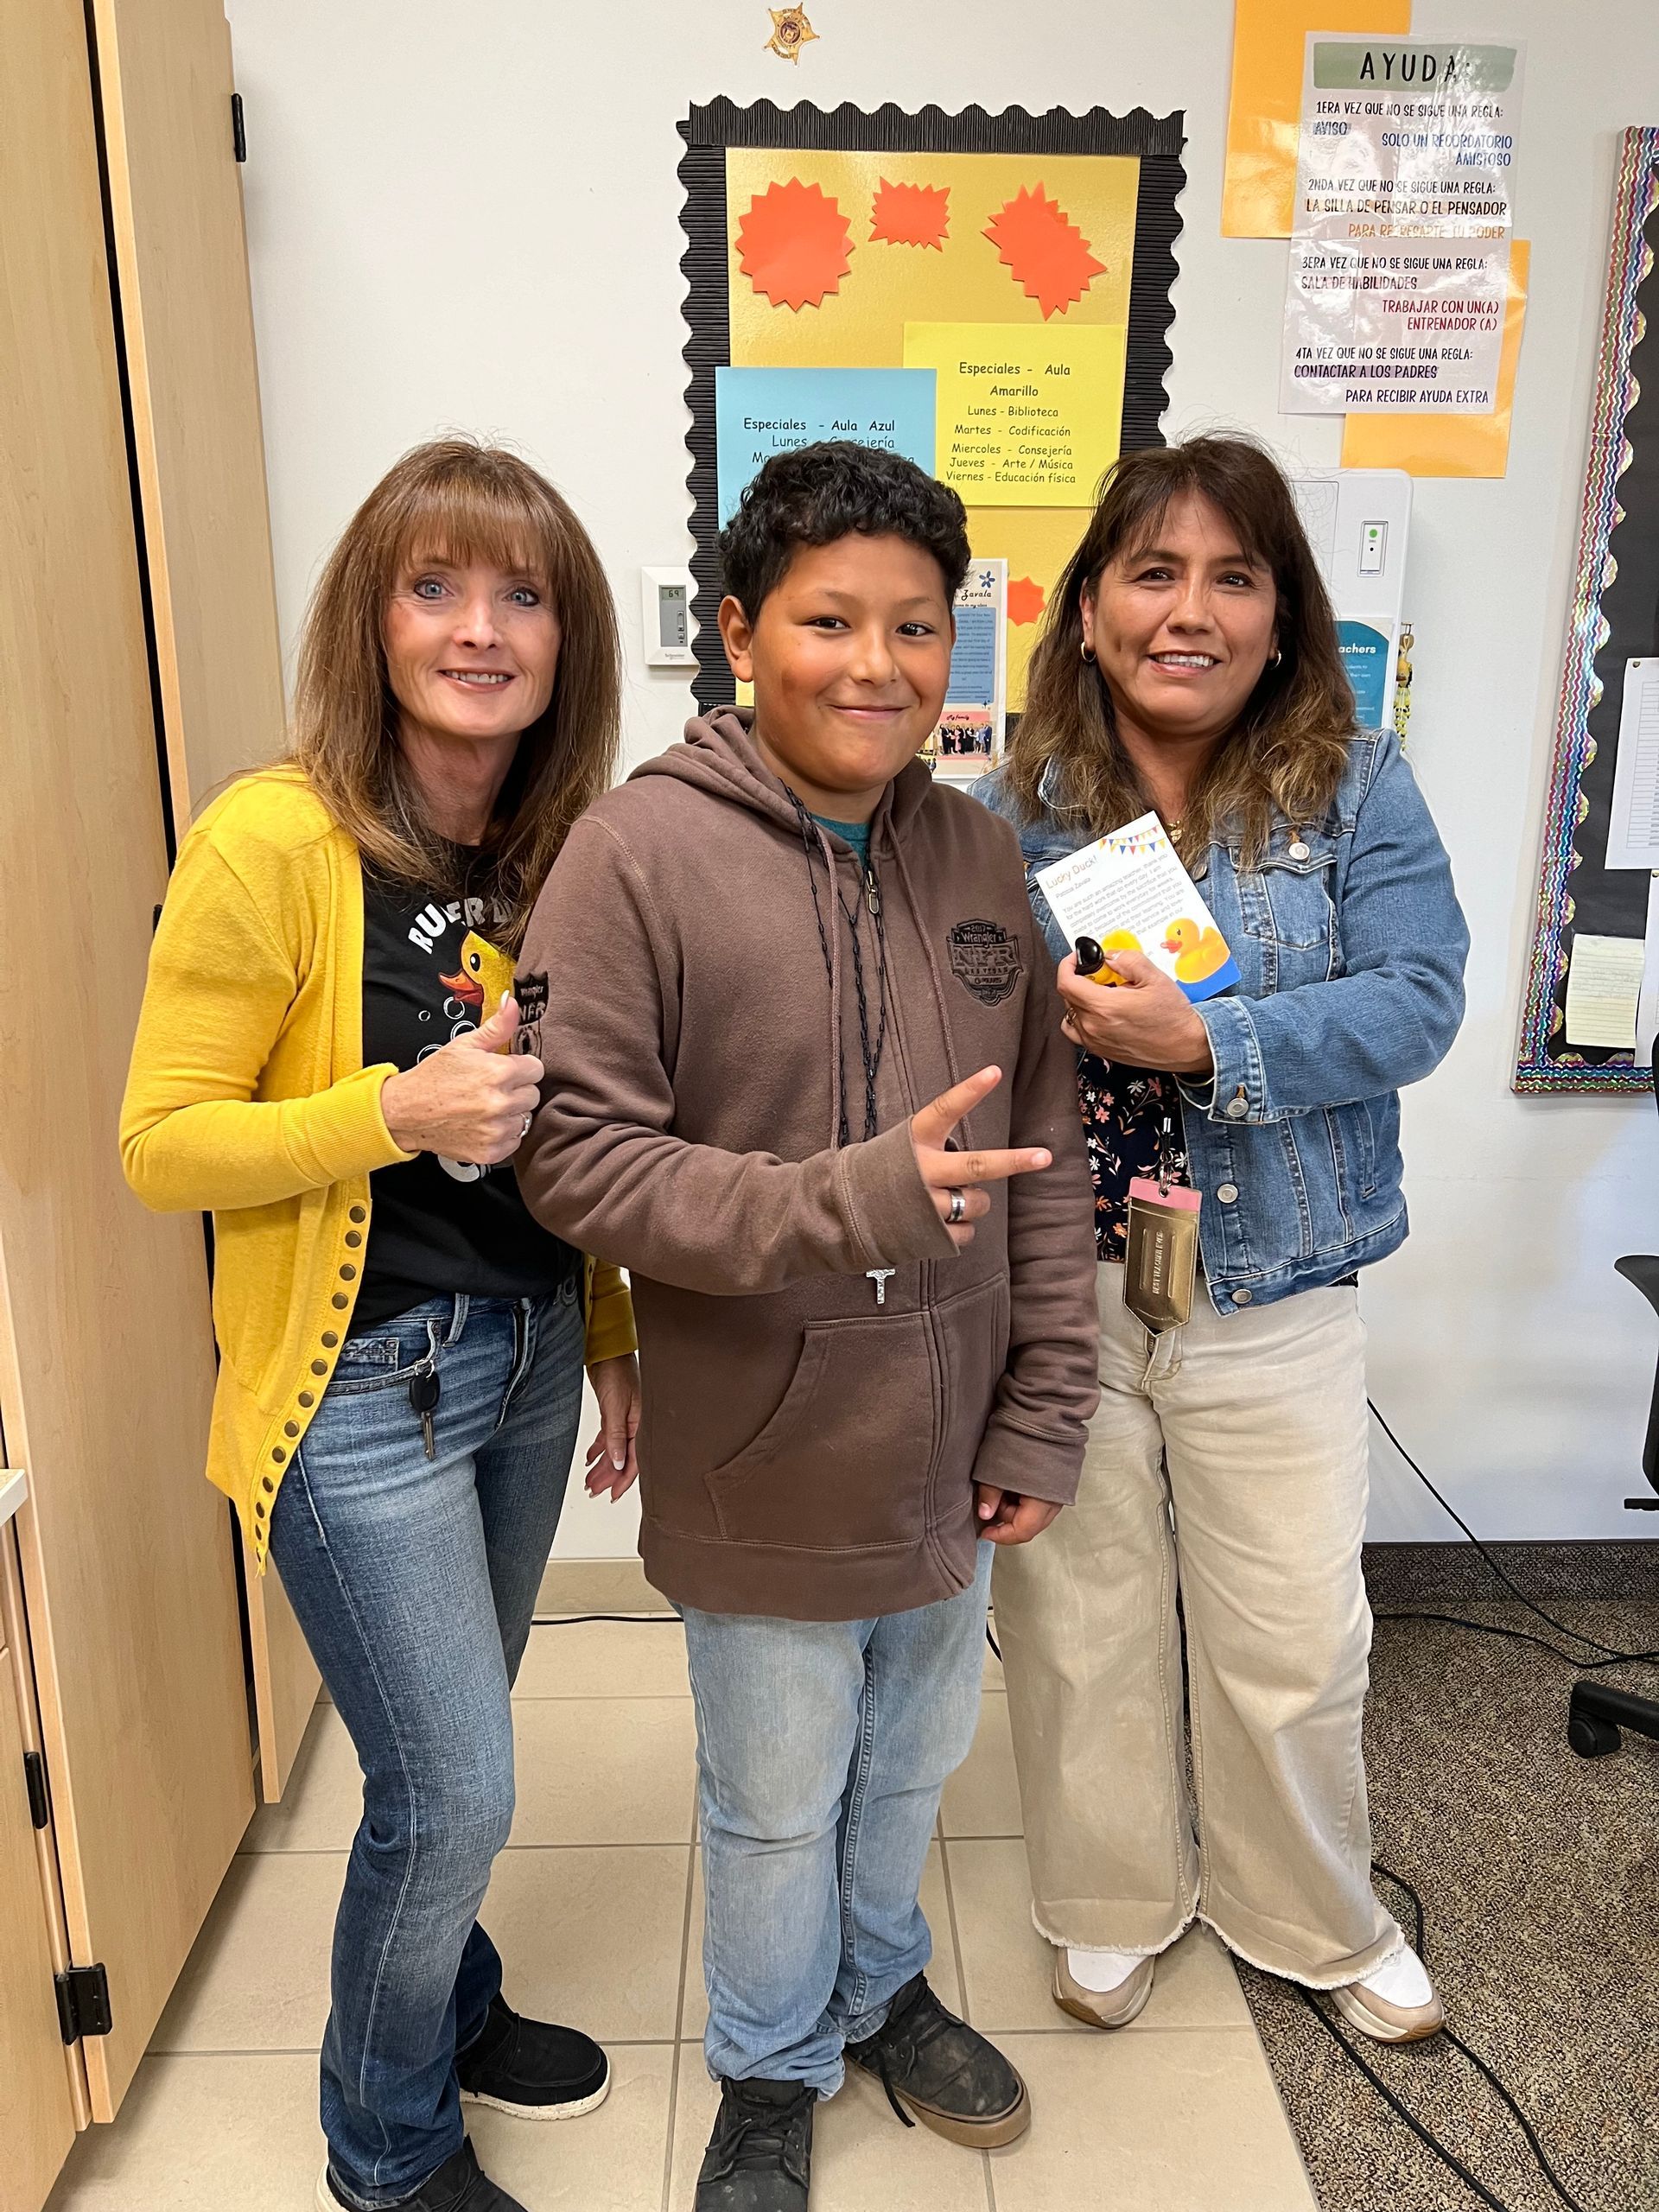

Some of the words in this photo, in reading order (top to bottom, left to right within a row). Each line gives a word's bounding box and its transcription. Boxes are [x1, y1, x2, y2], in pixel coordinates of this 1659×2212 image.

[1317, 102, 1339, 113] 1ERA
[1344, 102, 1362, 114] VEZ
[1365, 103, 1383, 116] QUE
[1387, 104, 1400, 116] NO
[1404, 105, 1414, 117] SE
[1419, 105, 1445, 117] SIGUE
[1448, 105, 1466, 117] UNA
[1471, 105, 1503, 118] REGLA:
[1314, 122, 1348, 135] AVISO
[1382, 133, 1408, 147] SOLO
[1414, 134, 1427, 147] UN
[1432, 134, 1512, 149] RECORDATORIO
[1456, 153, 1510, 166] AMISTOSO
[1308, 179, 1333, 191] 2NDA
[1339, 180, 1357, 191] VEZ
[1358, 180, 1376, 192] QUE
[1380, 181, 1394, 192] NO
[1396, 181, 1408, 193] SE
[1411, 181, 1437, 194] SIGUE
[1440, 181, 1459, 194] UNA
[1464, 181, 1496, 194] REGLA:
[1306, 199, 1321, 212] LA
[1325, 199, 1352, 212] SILLA
[1357, 200, 1370, 213] DE
[1375, 200, 1414, 214] PENSAR
[1421, 201, 1428, 213] O
[1432, 200, 1443, 214] EL
[1448, 201, 1507, 215] PENSADOR
[1349, 224, 1375, 238] PARA
[1380, 225, 1445, 238] RERESARTE
[1303, 257, 1325, 268] 3ERA
[1330, 257, 1346, 269] VEZ
[1351, 257, 1369, 269] QUE
[1372, 257, 1386, 269] NO
[1390, 257, 1400, 269] SE
[1404, 258, 1429, 269] SIGUE
[1433, 258, 1452, 270] UNA
[1456, 258, 1487, 270] REGLA:
[1301, 276, 1327, 289] SALA
[1332, 276, 1344, 289] DE
[1349, 276, 1417, 289] HABILIDADES
[1382, 300, 1437, 313] TRABAJAR
[1441, 301, 1463, 313] CON
[1467, 301, 1499, 314] UN(A)
[1408, 317, 1476, 330] ENTRENADOR
[1480, 318, 1497, 331] (A)
[1296, 347, 1312, 359] 4TA
[1317, 348, 1333, 359] VEZ
[1337, 348, 1355, 359] QUE
[1359, 348, 1372, 359] NO
[1376, 348, 1386, 359] SE
[1390, 348, 1414, 359] SIGUE
[1419, 349, 1437, 359] UNA
[1441, 349, 1472, 359] REGLA:
[959, 362, 1020, 377] Especiales
[1045, 364, 1071, 375] Aula
[1294, 365, 1357, 378] CONTACTAR
[1360, 365, 1366, 378] A
[1371, 365, 1390, 378] LOS
[1395, 365, 1437, 378] PADRES
[990, 385, 1038, 396] Amarillo
[1346, 390, 1372, 403] PARA
[1376, 390, 1416, 403] RECIBIR
[1420, 391, 1452, 403] AYUDA
[1457, 391, 1488, 403] EXTRA
[968, 406, 996, 416] Lunes
[1008, 406, 1058, 417] Biblioteca
[744, 418, 806, 431] Especiales
[831, 420, 857, 430] Aula
[869, 420, 894, 431] Azul
[955, 424, 991, 435] Martes
[1009, 426, 1071, 436] Codificación
[772, 435, 807, 447] Lunes
[951, 444, 1001, 454] Miercoles
[1019, 445, 1071, 457] Consejería
[950, 458, 984, 467] Jueves
[1002, 459, 1027, 468] Arte
[1039, 459, 1072, 469] Música
[946, 471, 983, 481] Viernes
[995, 472, 1044, 482] Educación
[1048, 473, 1076, 483] física
[961, 589, 992, 601] Zavala
[1338, 643, 1376, 653] achers
[1046, 871, 1071, 889] Lucky
[1071, 855, 1097, 874] Duck!
[961, 932, 996, 945] Wrangler
